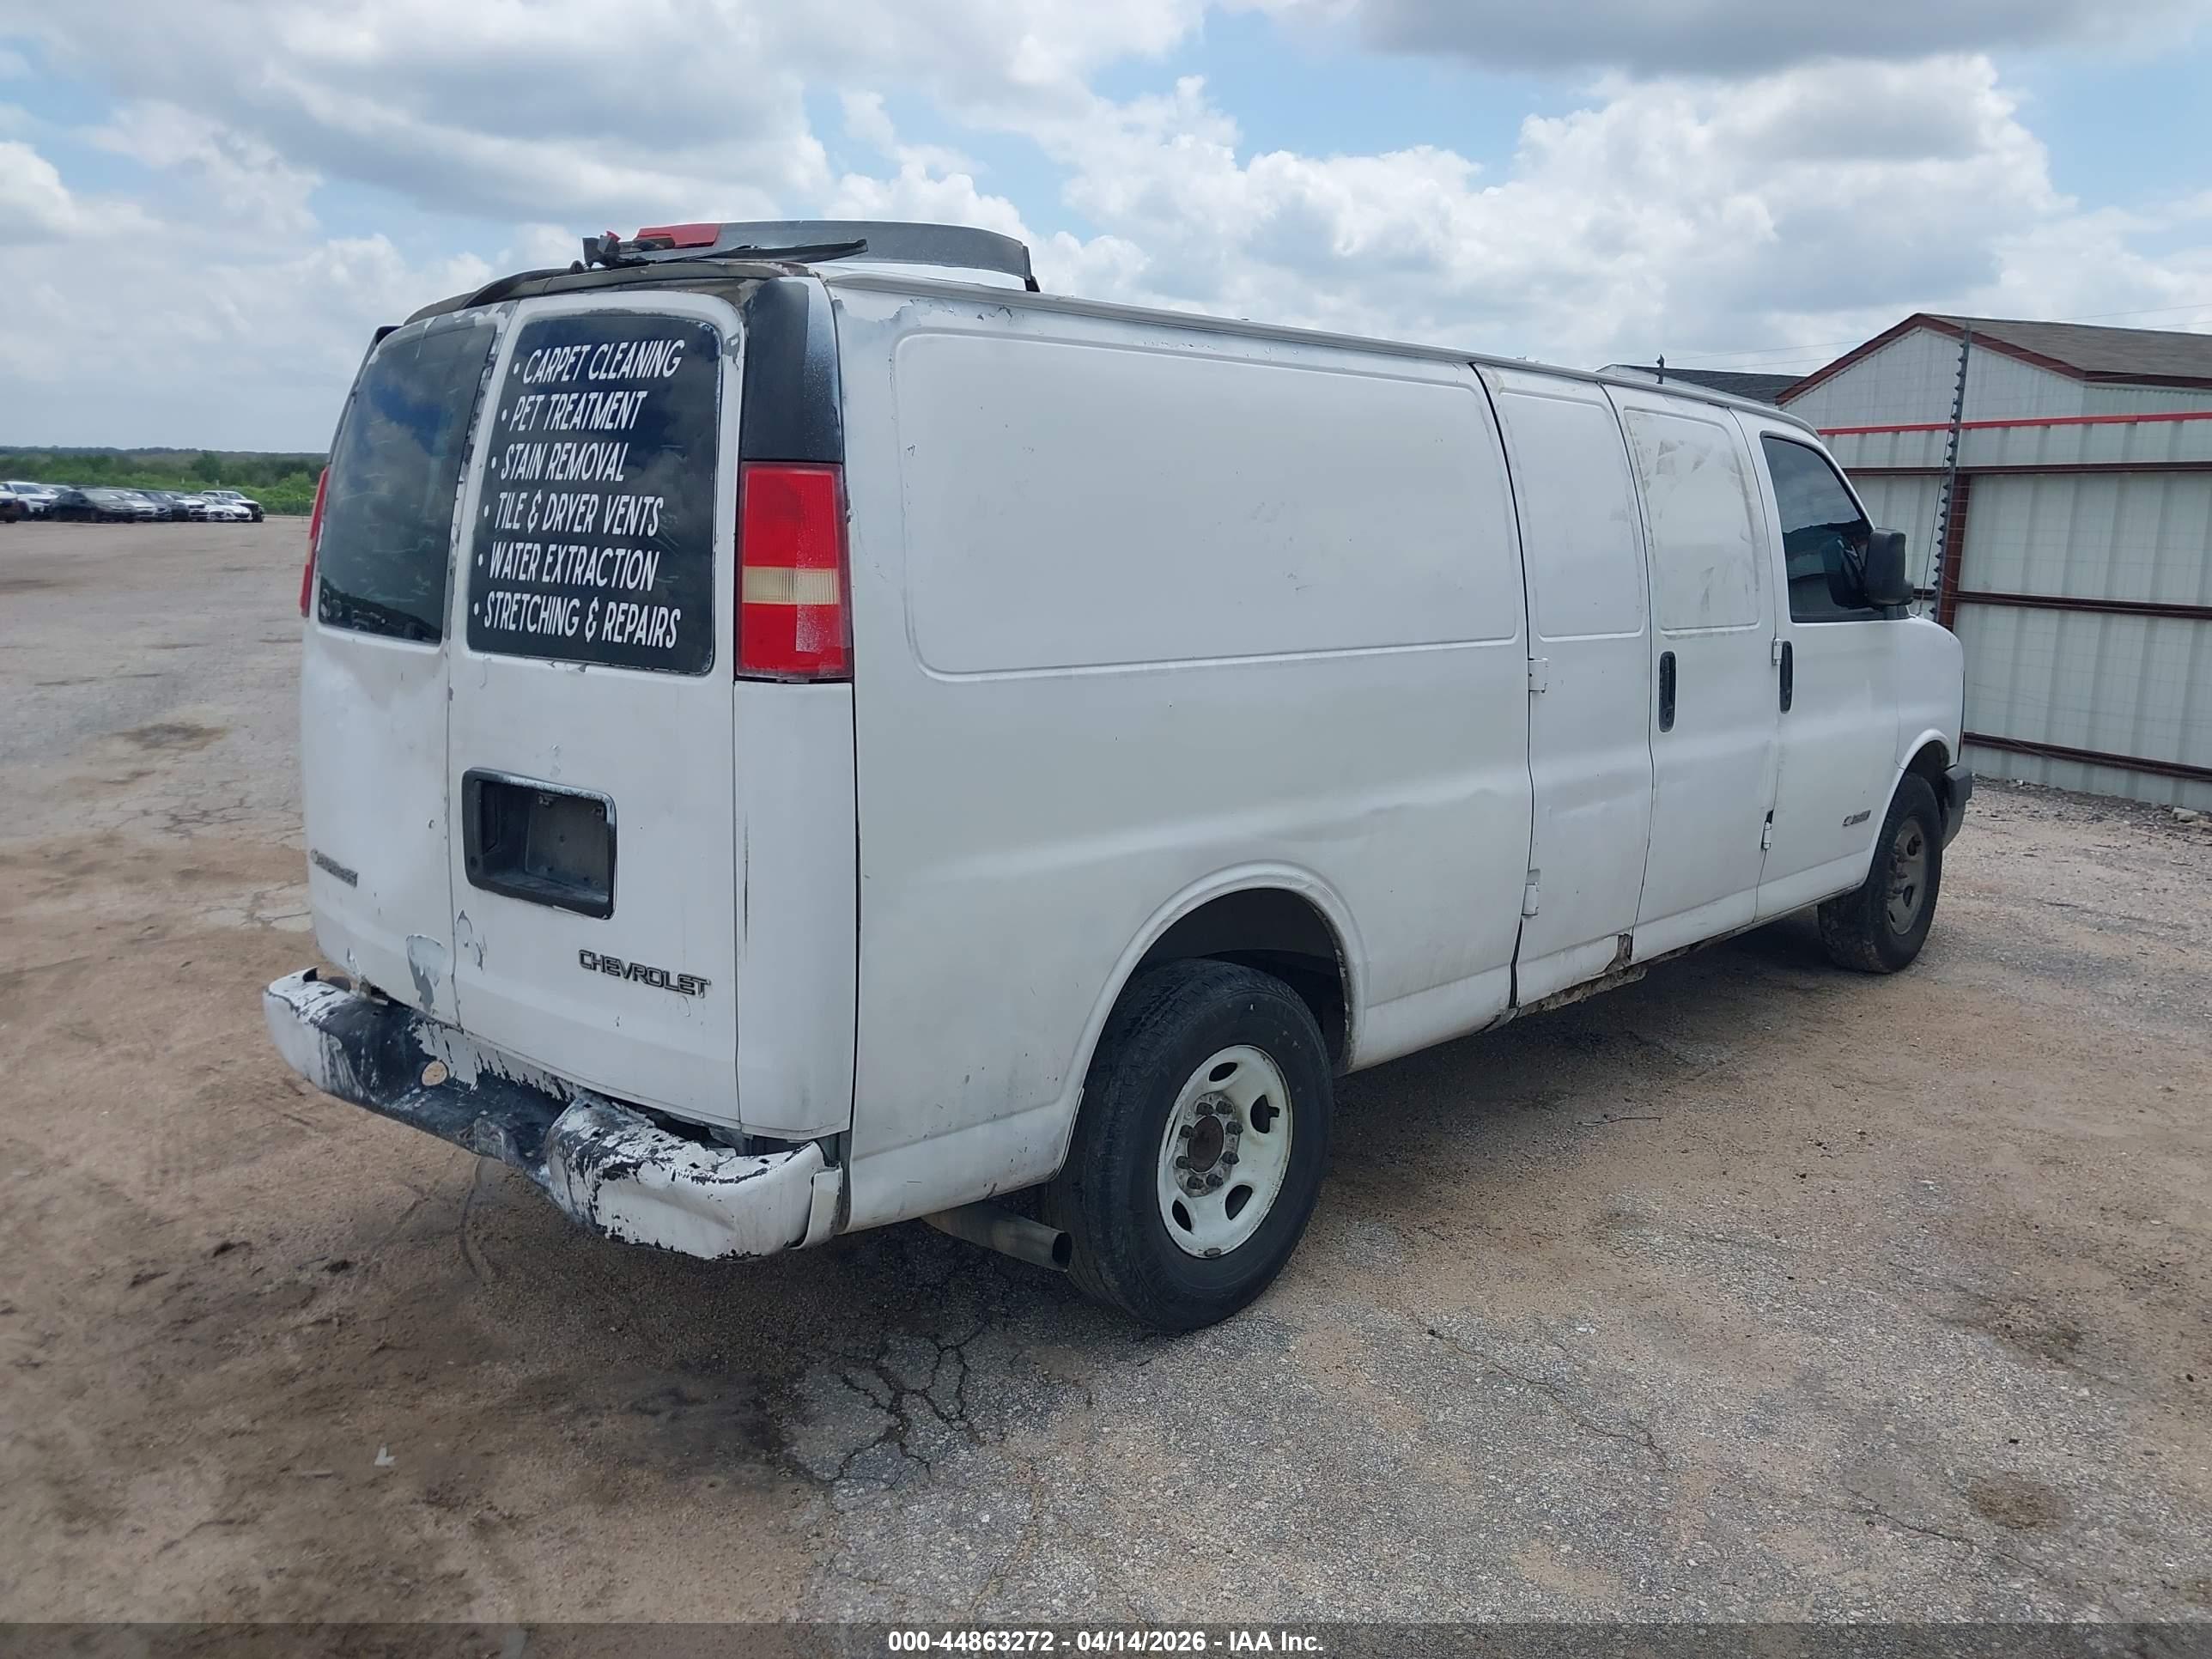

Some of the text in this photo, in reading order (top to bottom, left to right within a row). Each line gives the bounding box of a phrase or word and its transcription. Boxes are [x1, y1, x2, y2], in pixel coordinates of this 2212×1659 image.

[523, 339, 685, 385] CARPET CLEANING
[508, 391, 648, 432] PET TREATMENT
[501, 442, 629, 483] STAIN REMOVAL
[495, 489, 664, 537] TILE & DRYER VENTS
[489, 541, 660, 592] WATER EXTRACTION
[483, 591, 681, 649] STRETCHING & REPAIRS
[578, 949, 710, 998] CHEVROLET
